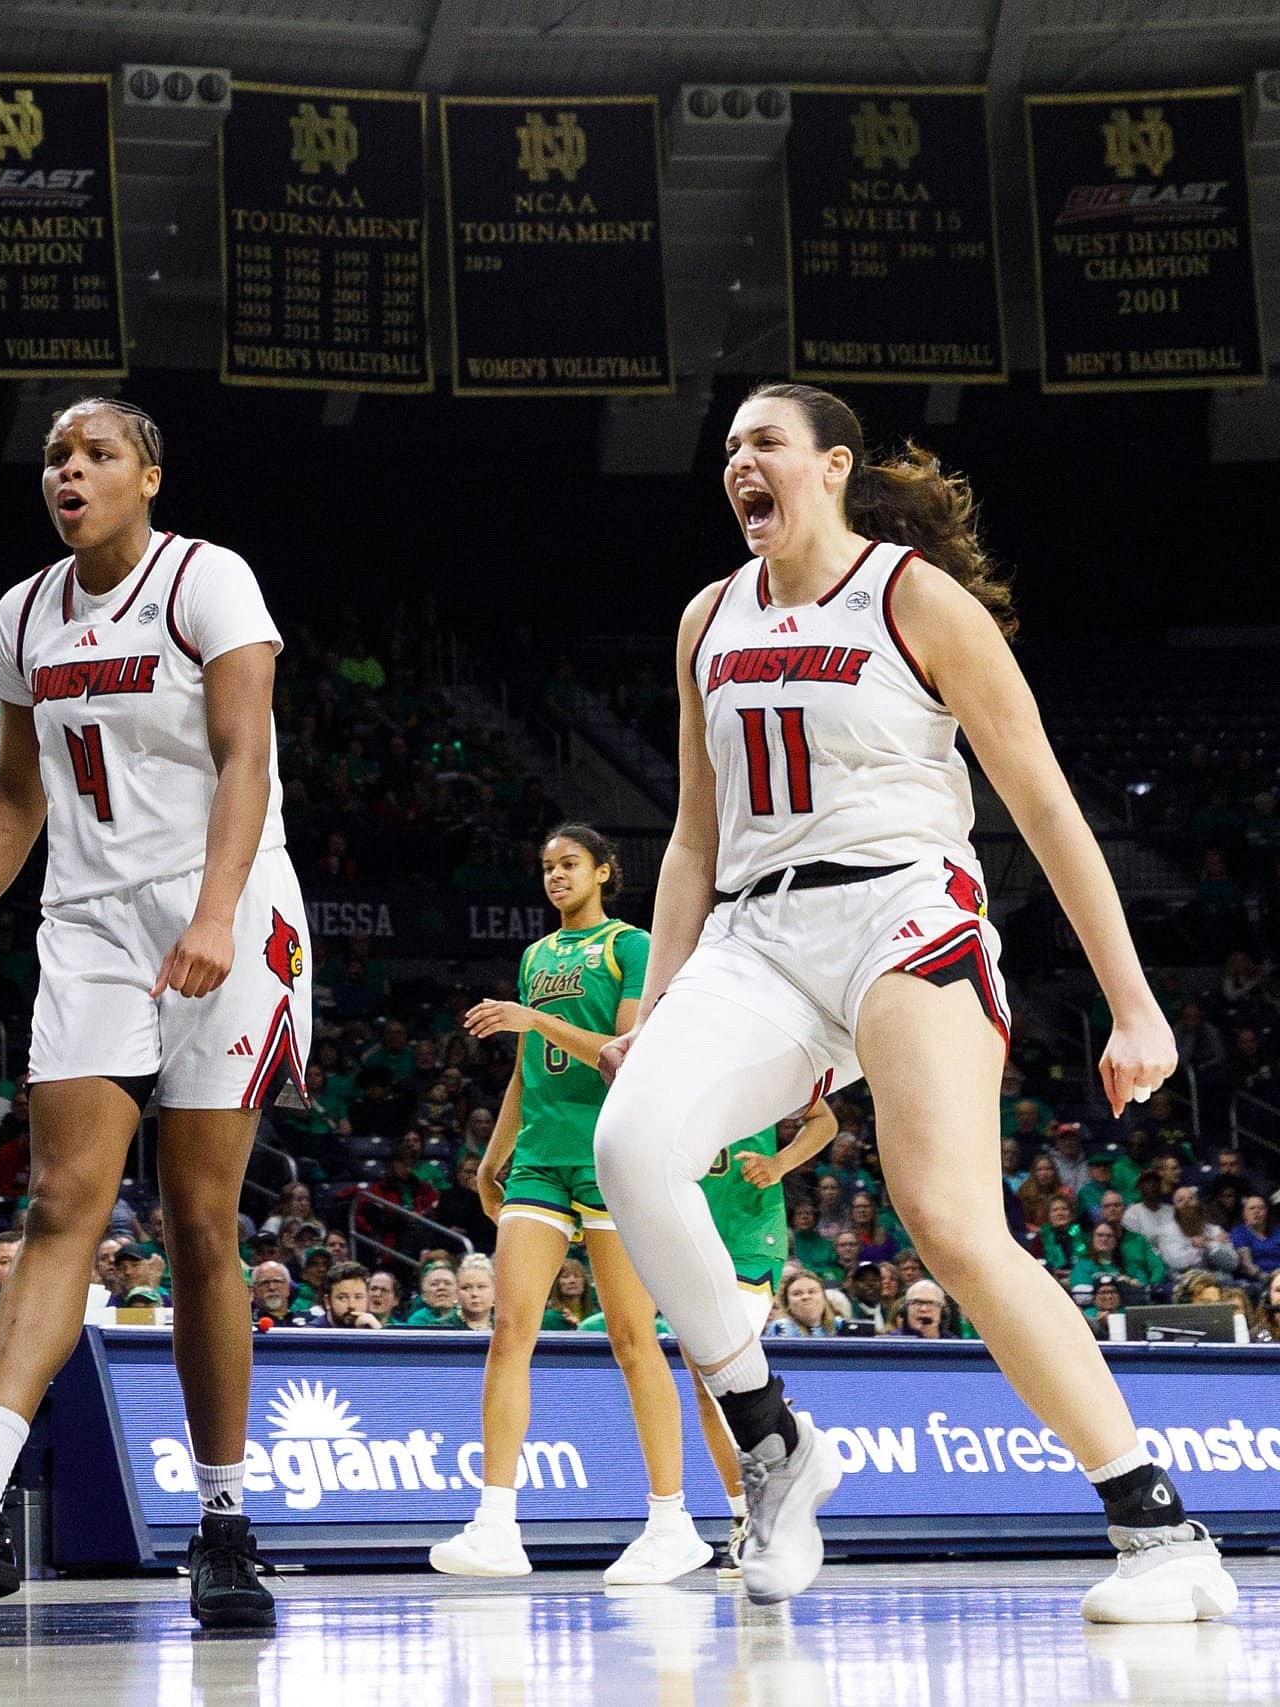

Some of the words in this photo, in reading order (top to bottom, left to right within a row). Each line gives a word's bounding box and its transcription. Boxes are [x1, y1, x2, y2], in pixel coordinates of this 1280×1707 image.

[286, 184, 367, 208] NCAA
[515, 192, 597, 214] NCAA
[849, 181, 930, 202] NCAA
[231, 208, 419, 240] TOURNAMENT
[460, 222, 654, 243] TOURNAMENT
[823, 207, 918, 231] SWEET
[1053, 231, 1121, 256] WEST
[1127, 227, 1238, 253] DIVISION
[1084, 254, 1209, 280] CHAMPION
[20, 275, 58, 290] 1997
[21, 295, 60, 310] 2002
[1117, 287, 1180, 315] 2001
[4, 338, 115, 360] VOLLEYBALL
[232, 344, 311, 370] WOMEN'S
[316, 349, 421, 374] VOLLEYBALL
[802, 339, 883, 364] WOMEN'S
[887, 343, 993, 366] VOLLEYBALL
[1065, 351, 1122, 375] MEN'S
[1128, 346, 1241, 373] BASKETBALL
[467, 357, 547, 379] WOMEN'S
[553, 356, 662, 379] VOLLEYBALL
[30, 655, 160, 706] LOUISVILLE
[706, 646, 873, 697] LOUISVILLE
[62, 723, 113, 822] 4
[735, 707, 814, 816] 11
[469, 904, 544, 938] LEAH
[528, 965, 585, 1004] Irish
[797, 1411, 917, 1474] ow
[150, 1421, 587, 1510] aegiant.cm
